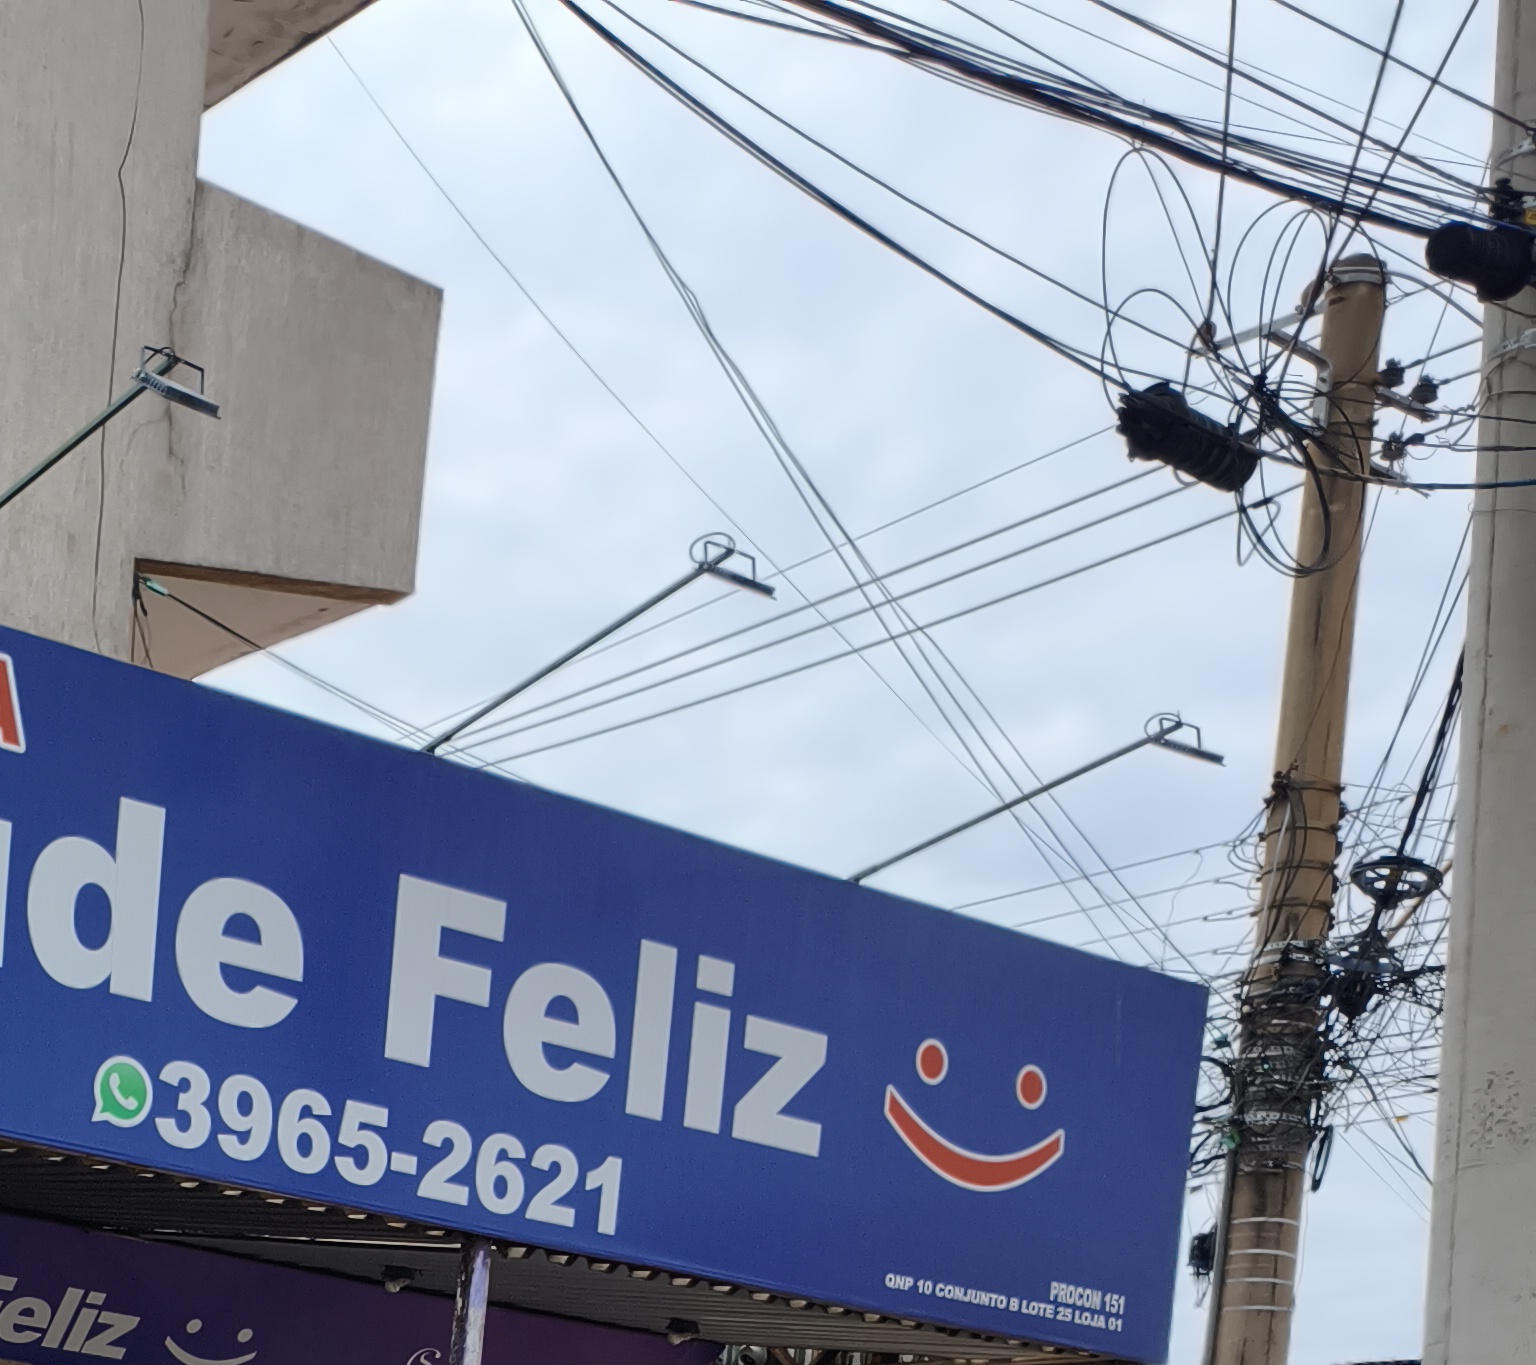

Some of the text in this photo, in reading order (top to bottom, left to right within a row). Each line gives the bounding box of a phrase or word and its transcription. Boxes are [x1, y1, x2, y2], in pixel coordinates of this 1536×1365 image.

[385, 874, 828, 1157] Feliz
[154, 1060, 624, 1237] 3965-2621
[885, 1272, 914, 1292] QNP
[916, 1279, 933, 1296] 10
[935, 1283, 1007, 1310] CONJUNTO
[1020, 1300, 1055, 1319] LOTE
[1056, 1307, 1073, 1322] 25
[1073, 1310, 1106, 1329] LOJA
[1107, 1317, 1123, 1332] 01
[1049, 1281, 1126, 1315] PROCON 151
